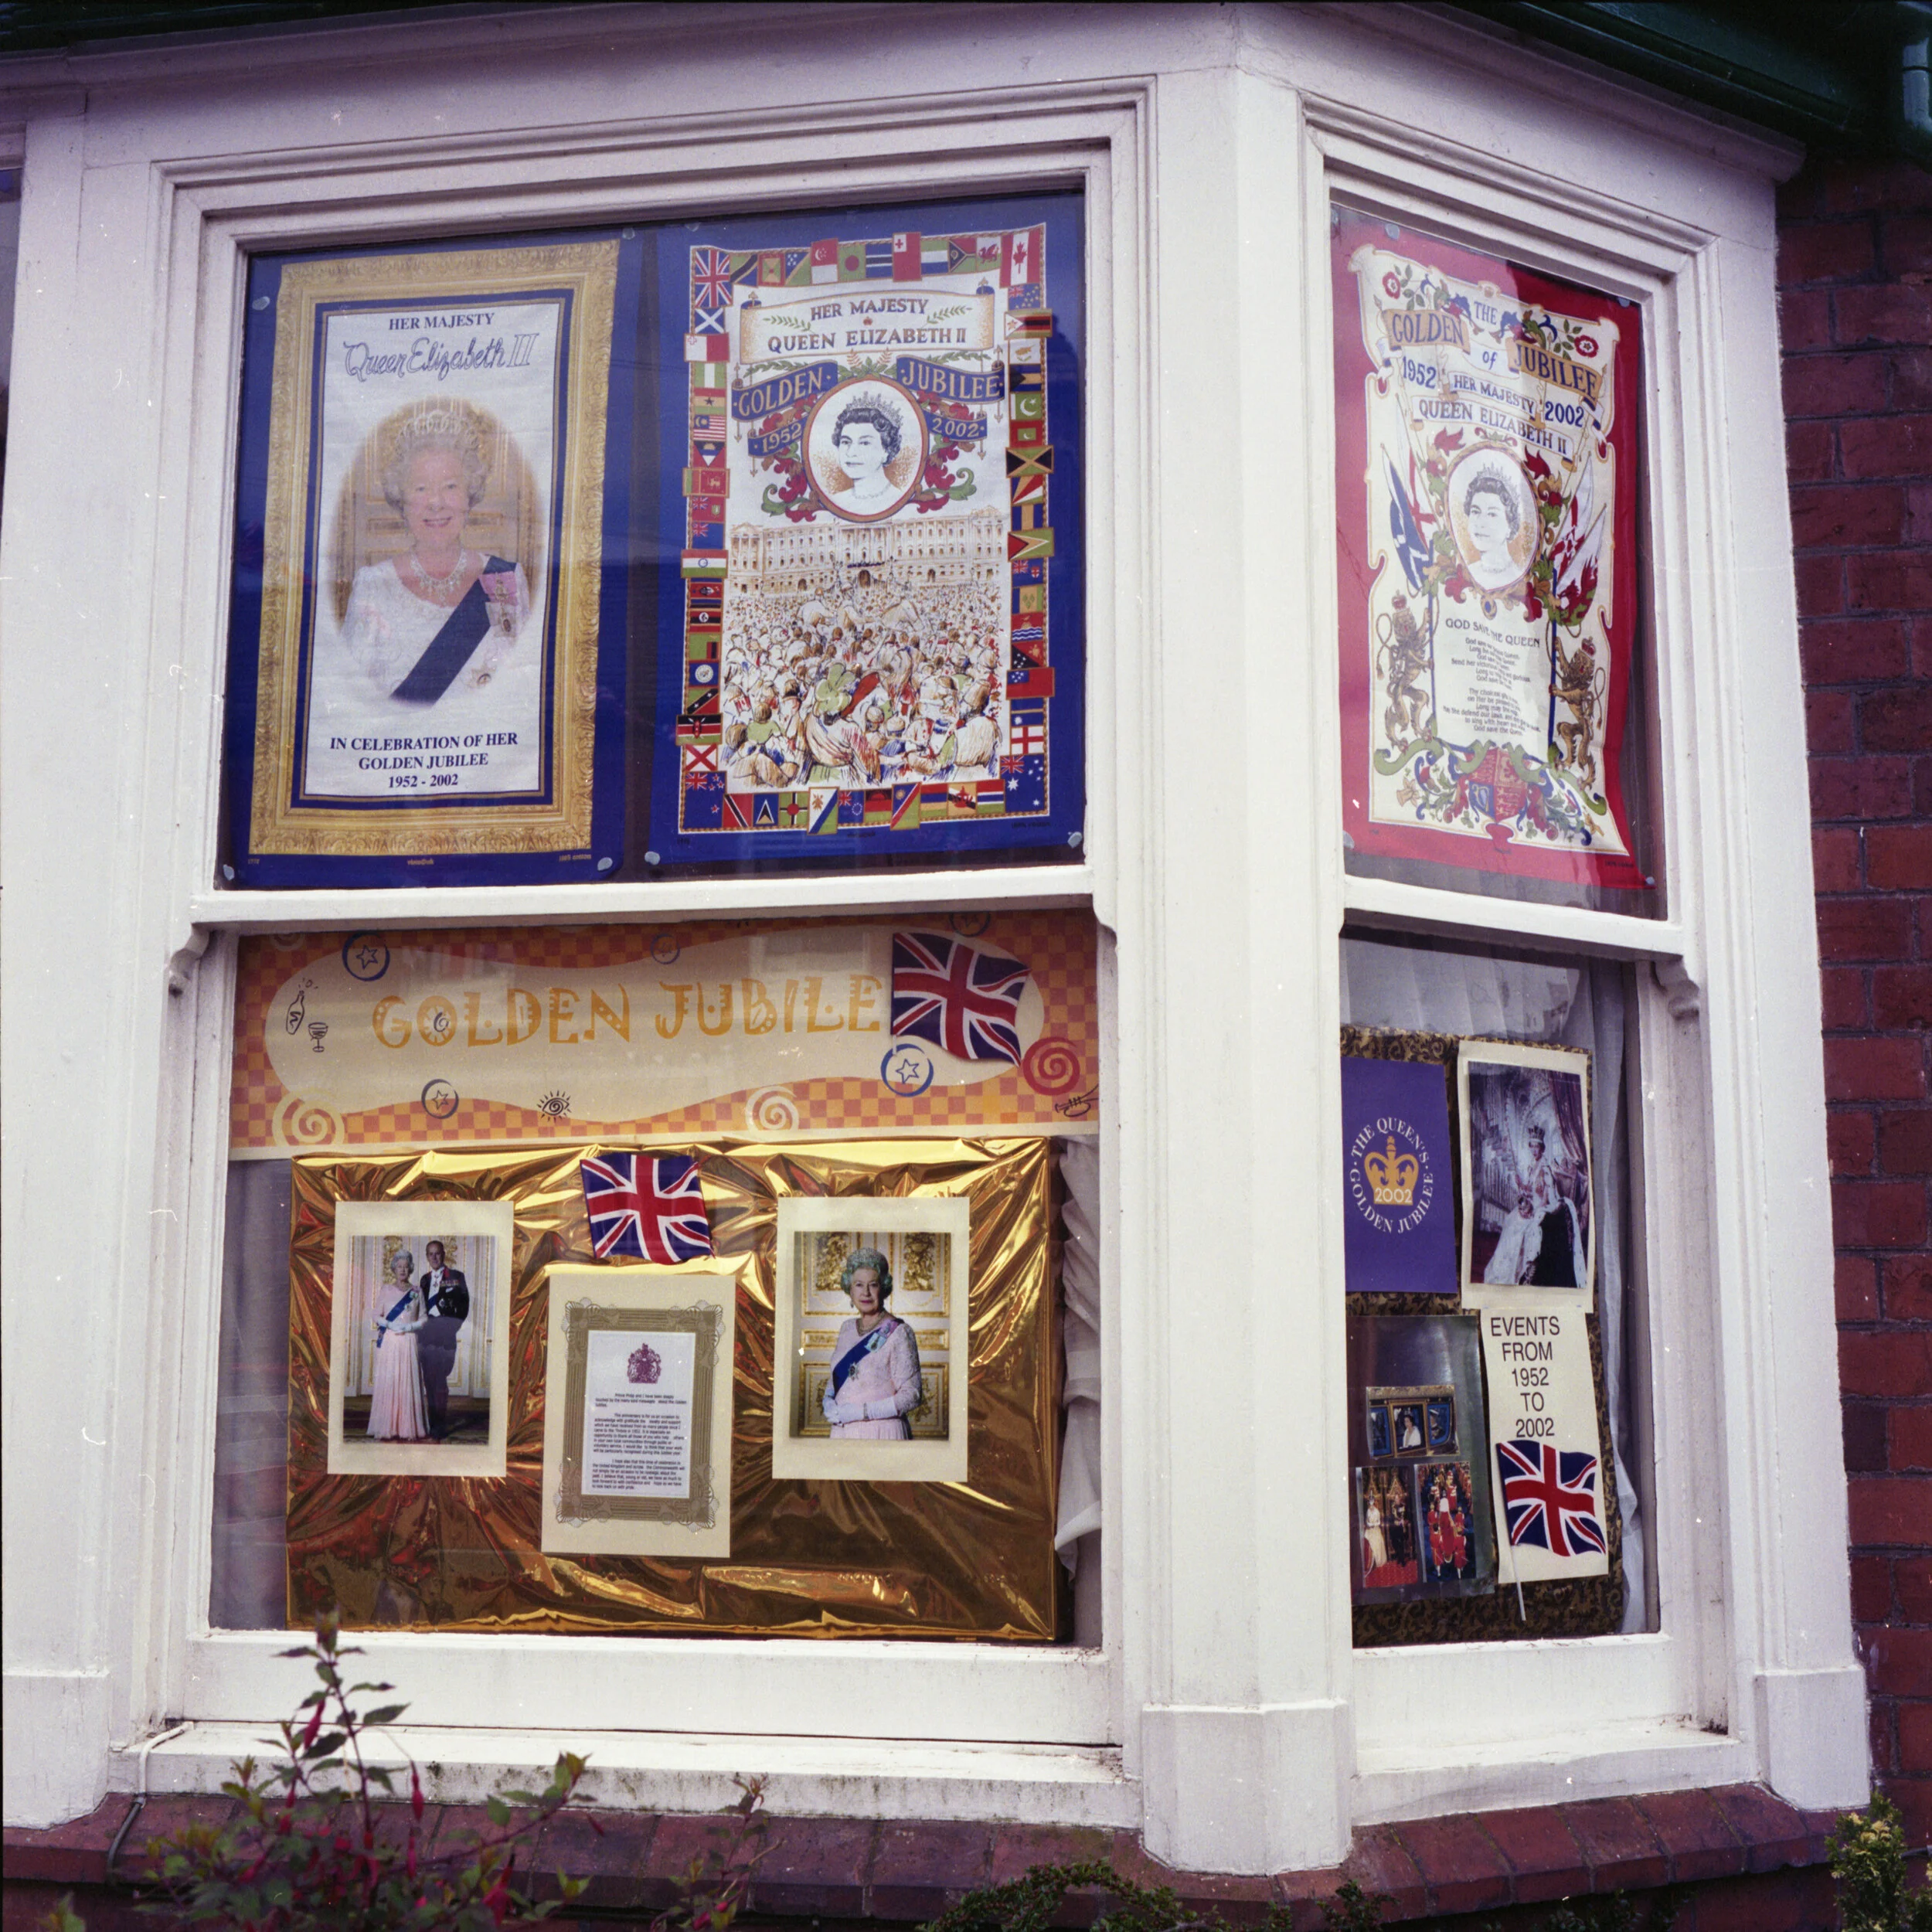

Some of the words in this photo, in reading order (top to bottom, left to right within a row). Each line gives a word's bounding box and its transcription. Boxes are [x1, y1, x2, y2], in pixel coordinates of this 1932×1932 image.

[389, 316, 420, 331] HER
[423, 312, 495, 329] MAJESTY
[811, 302, 842, 321] HER
[850, 299, 929, 315] MAJESTY
[1474, 301, 1498, 325] THE
[767, 332, 836, 354] QUEEN
[845, 328, 952, 346] ELIZABETH
[957, 328, 968, 343] II
[1392, 313, 1464, 347] GOLDEN
[343, 340, 408, 382] Queen
[406, 336, 505, 381] Elizabeth
[505, 333, 540, 369] II
[1403, 355, 1437, 389] 1952
[1514, 343, 1597, 401] JUBILEE
[738, 366, 823, 417] GOLDEN
[901, 360, 1001, 400] JUBILEE
[1454, 374, 1477, 392] HER
[1481, 382, 1535, 414] MAJESTY
[1419, 399, 1473, 420] QUEEN
[1481, 406, 1553, 449] ELIZABETH
[1557, 437, 1566, 454] II
[1545, 400, 1584, 428] 2002
[762, 422, 802, 453] 1952
[932, 417, 980, 437] 2002
[1445, 617, 1471, 630] GOD
[1505, 634, 1540, 648] QUEEN
[330, 736, 347, 750] IN
[351, 735, 461, 751] CELEBRATION
[464, 734, 483, 748] OF
[485, 732, 519, 747] HER
[359, 756, 424, 770] GOLDEN
[427, 753, 489, 770] JUBILEE
[388, 775, 418, 788] 1952
[430, 774, 459, 787] 2002
[372, 982, 631, 1049] GOLDEN
[655, 974, 883, 1039] JUBILE
[1351, 1124, 1376, 1158] THE
[1376, 1116, 1430, 1164] QUEEN'S
[1349, 1168, 1394, 1234] GOLDEN
[1397, 1172, 1434, 1234] JUBILEE
[1375, 1187, 1413, 1203] 2002
[1490, 1315, 1560, 1337] EVENTS
[1502, 1341, 1553, 1362] FROM
[1511, 1366, 1549, 1387] 1952
[1520, 1391, 1545, 1412] TO
[1515, 1417, 1555, 1438] 2002
